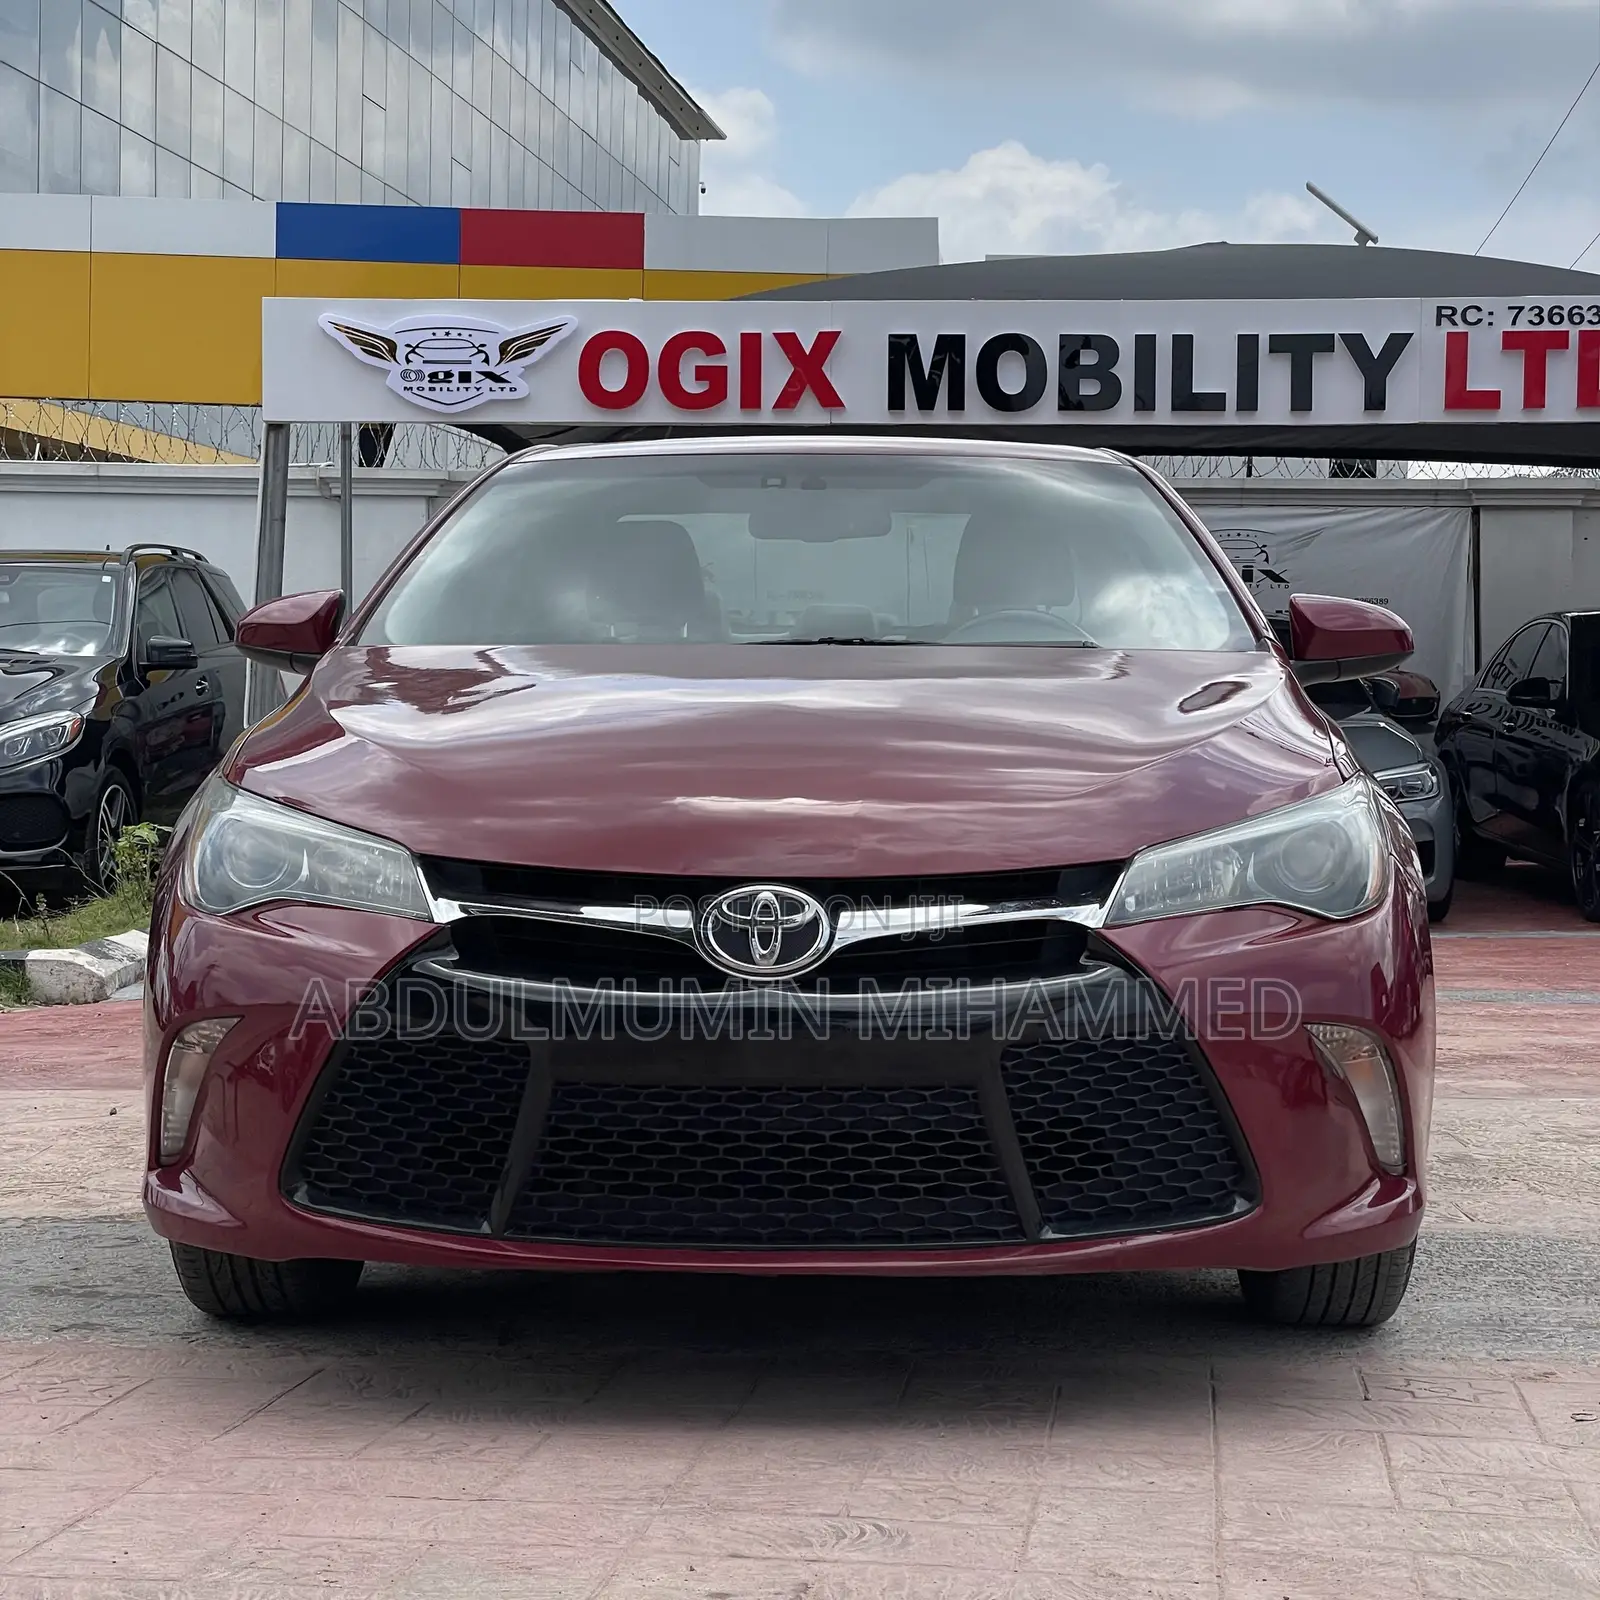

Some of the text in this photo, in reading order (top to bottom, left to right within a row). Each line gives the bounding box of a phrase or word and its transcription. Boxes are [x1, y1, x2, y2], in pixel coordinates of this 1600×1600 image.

[1434, 304, 1600, 327] RC: 73663
[577, 330, 847, 411] OGIX
[886, 332, 1415, 413] MOBILITY
